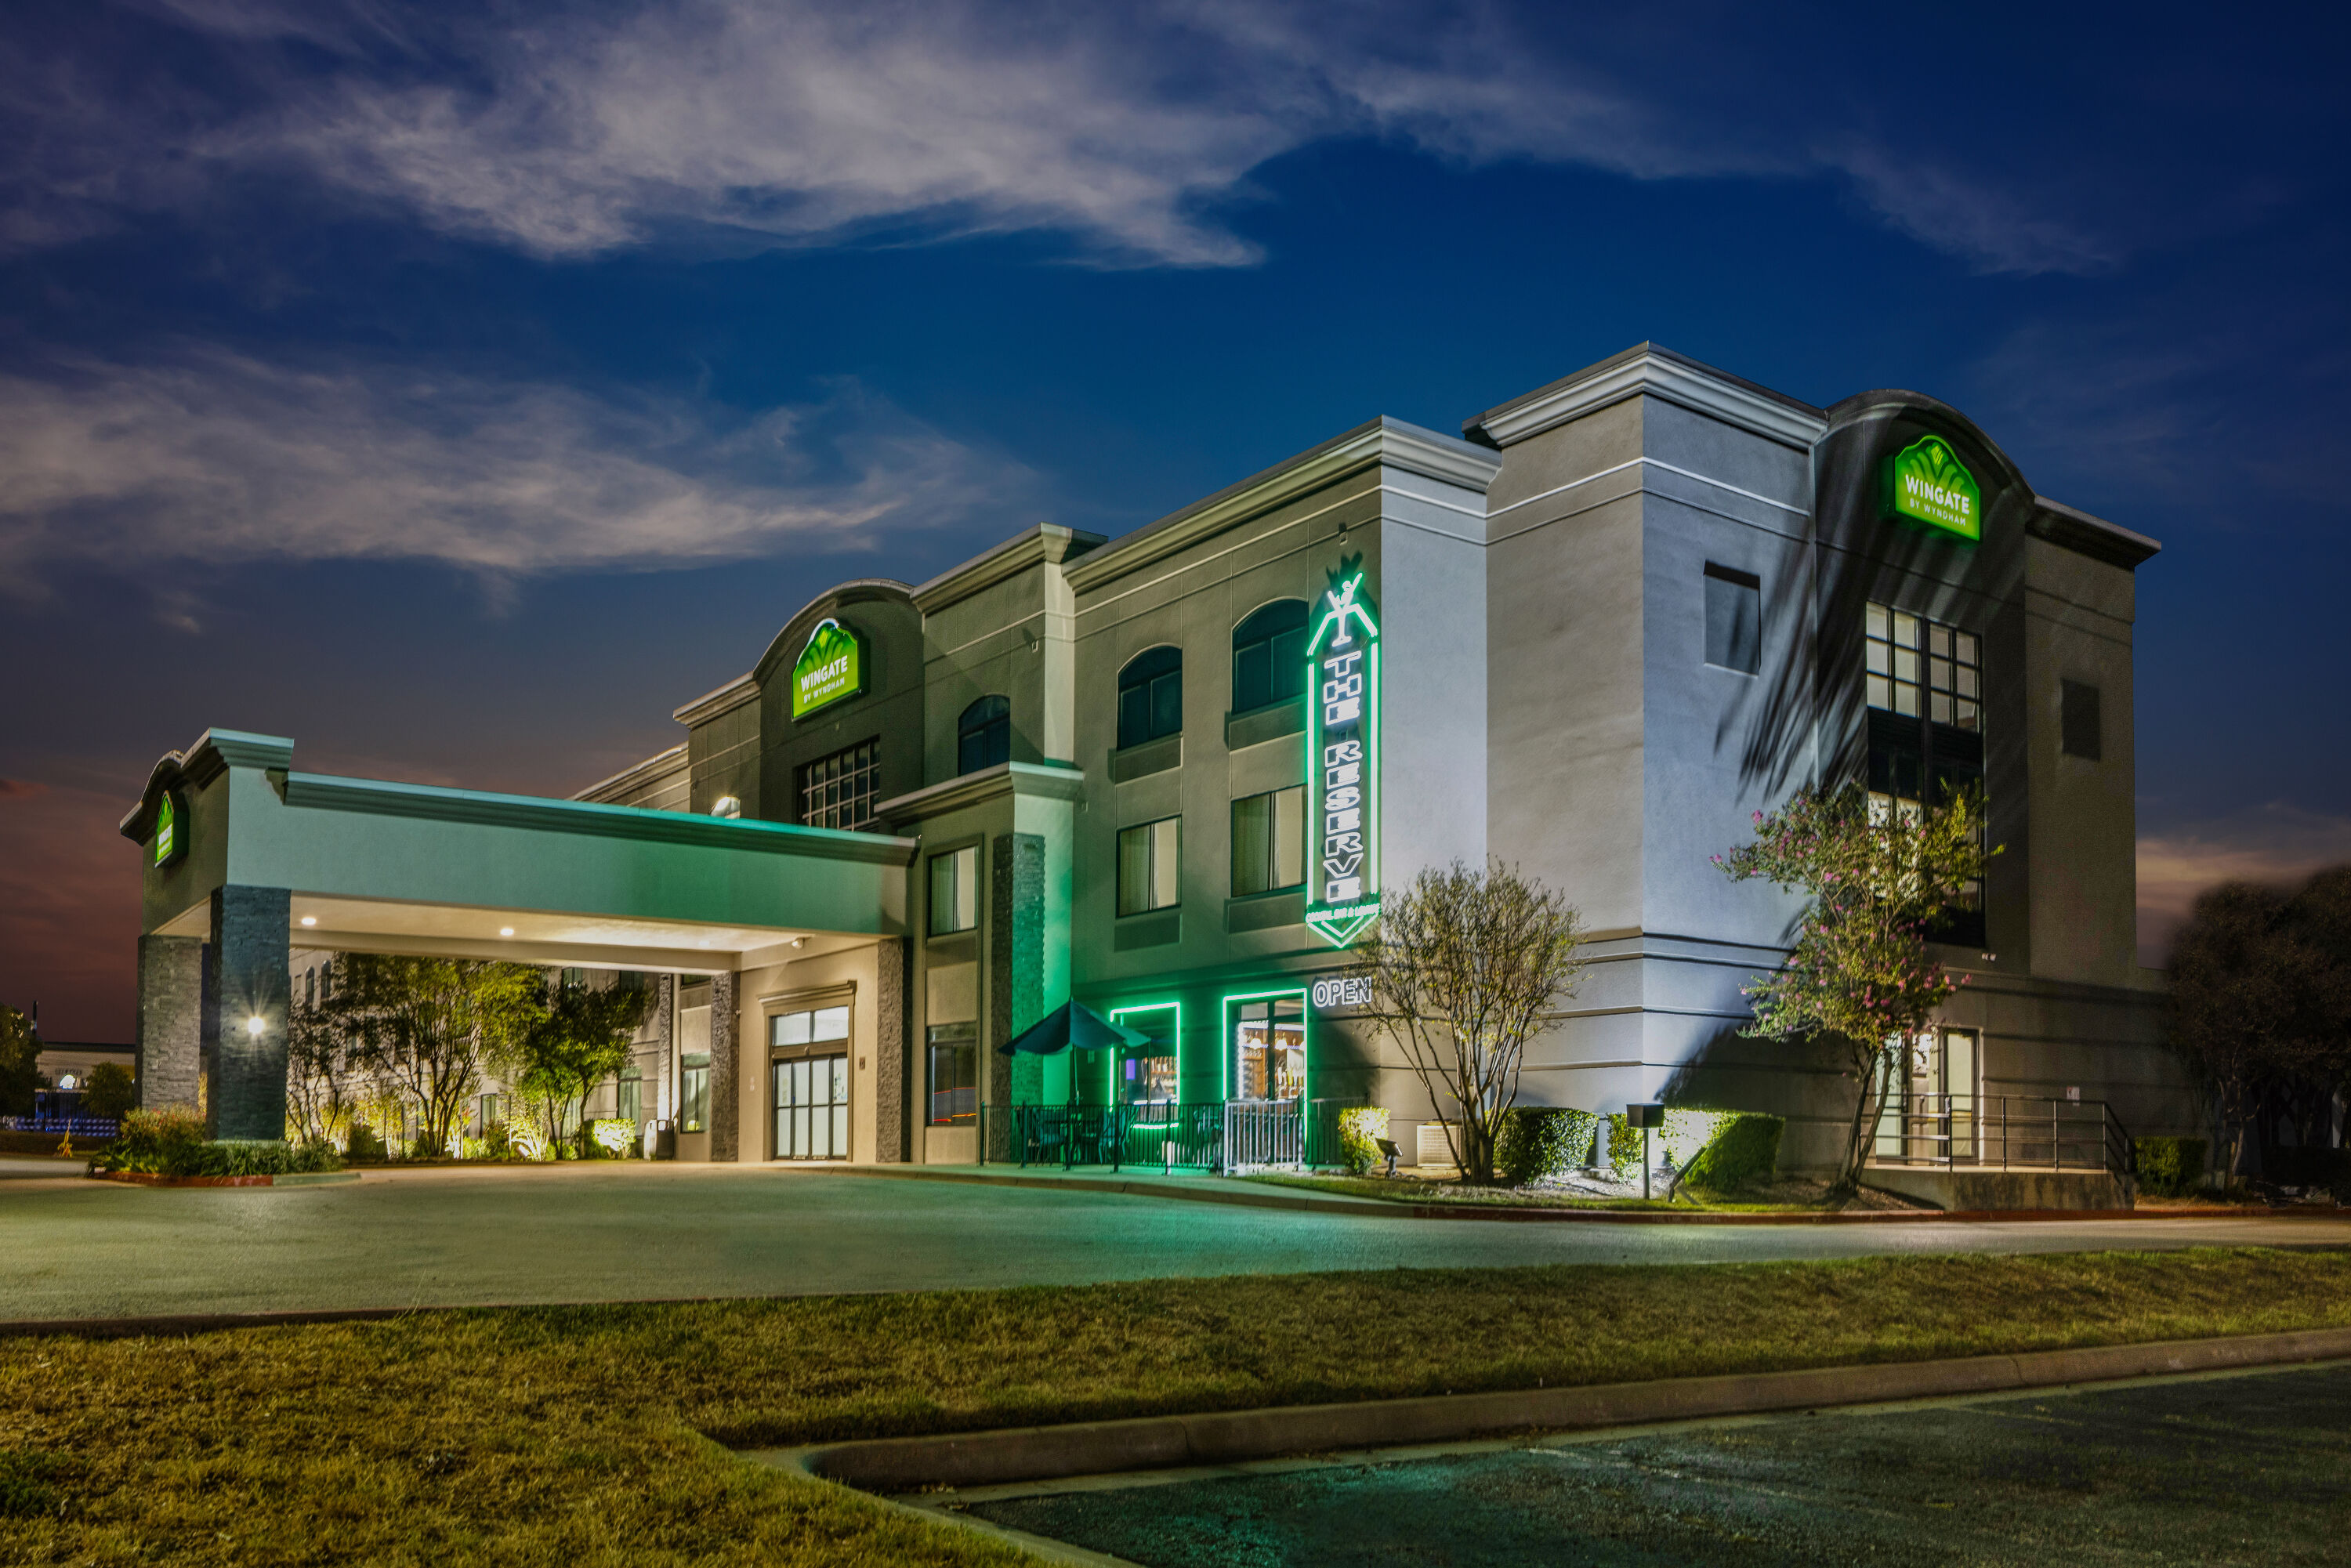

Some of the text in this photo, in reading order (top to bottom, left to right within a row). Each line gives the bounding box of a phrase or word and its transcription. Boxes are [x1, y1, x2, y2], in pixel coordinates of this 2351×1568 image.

[1905, 473, 1970, 515] WINGATE
[1910, 498, 1966, 527] BY WYNDHAM
[801, 654, 848, 693] WINGATE
[803, 676, 845, 704] BY WYNDHAM
[1323, 650, 1364, 903] THE RESERVE
[1313, 976, 1372, 1008] OPEN
